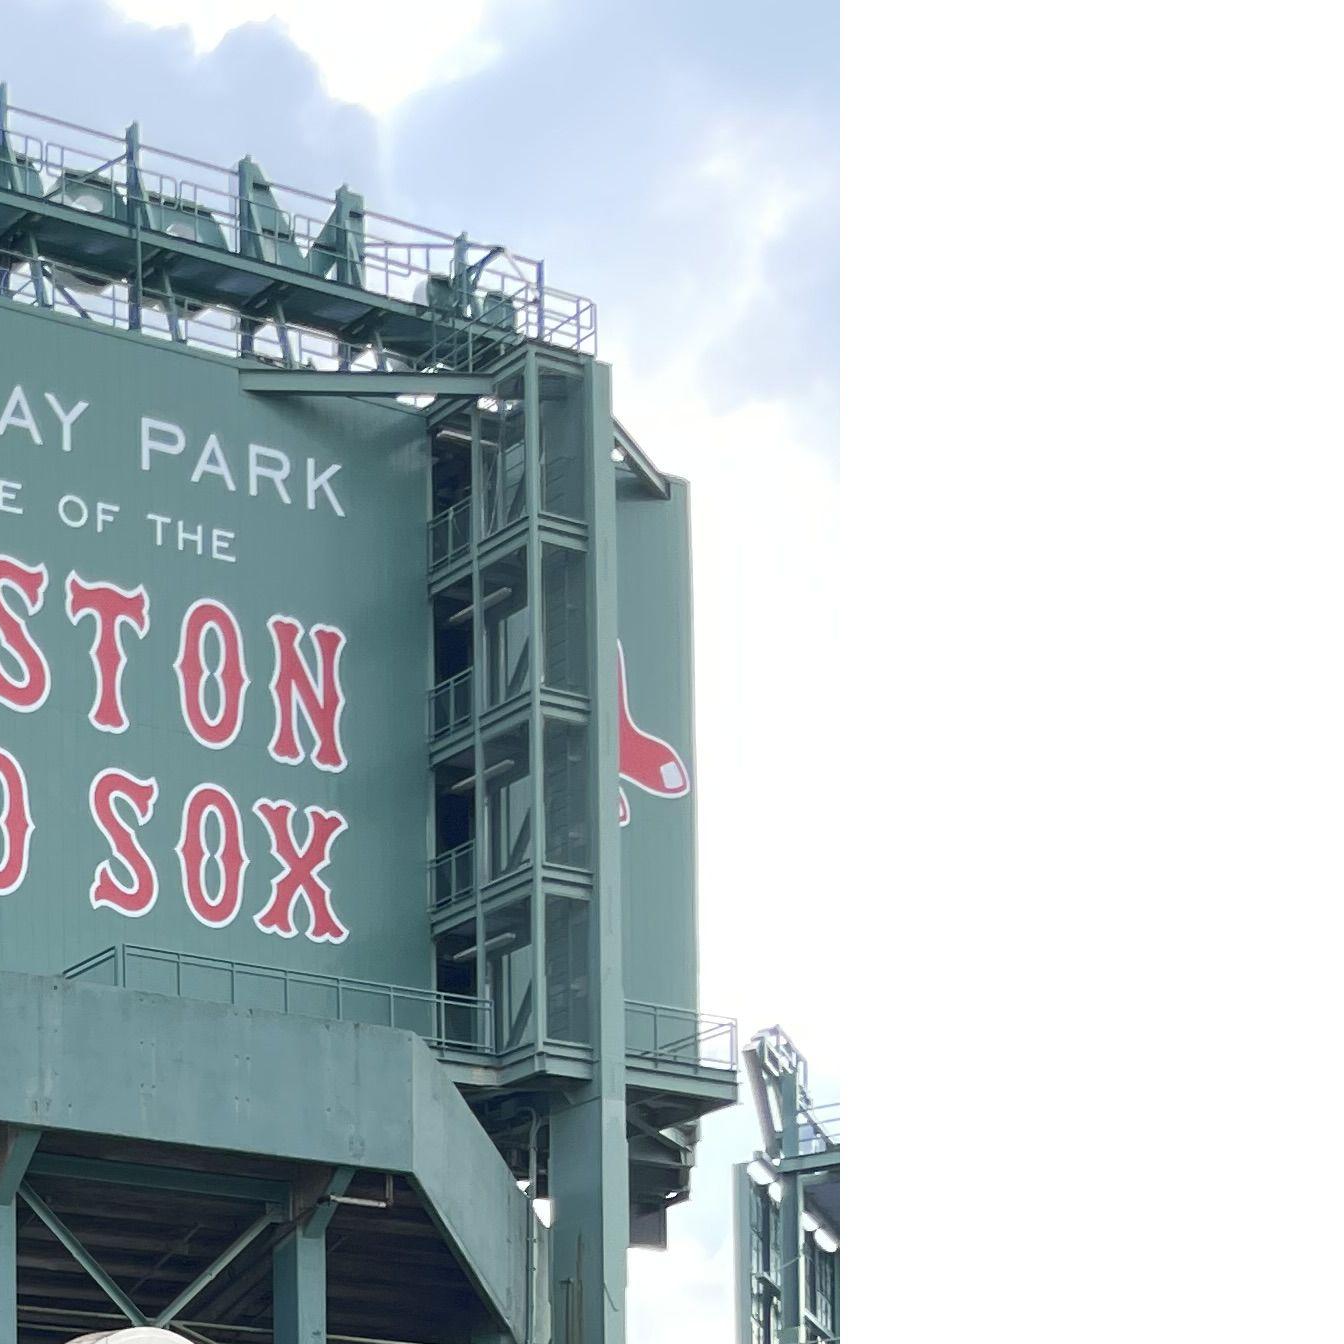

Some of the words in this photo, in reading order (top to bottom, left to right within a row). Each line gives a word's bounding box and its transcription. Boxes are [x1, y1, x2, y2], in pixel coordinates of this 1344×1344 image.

[139, 417, 346, 517] PARK
[59, 495, 120, 533] OF
[148, 514, 237, 563] THE
[89, 768, 349, 944] SOX
